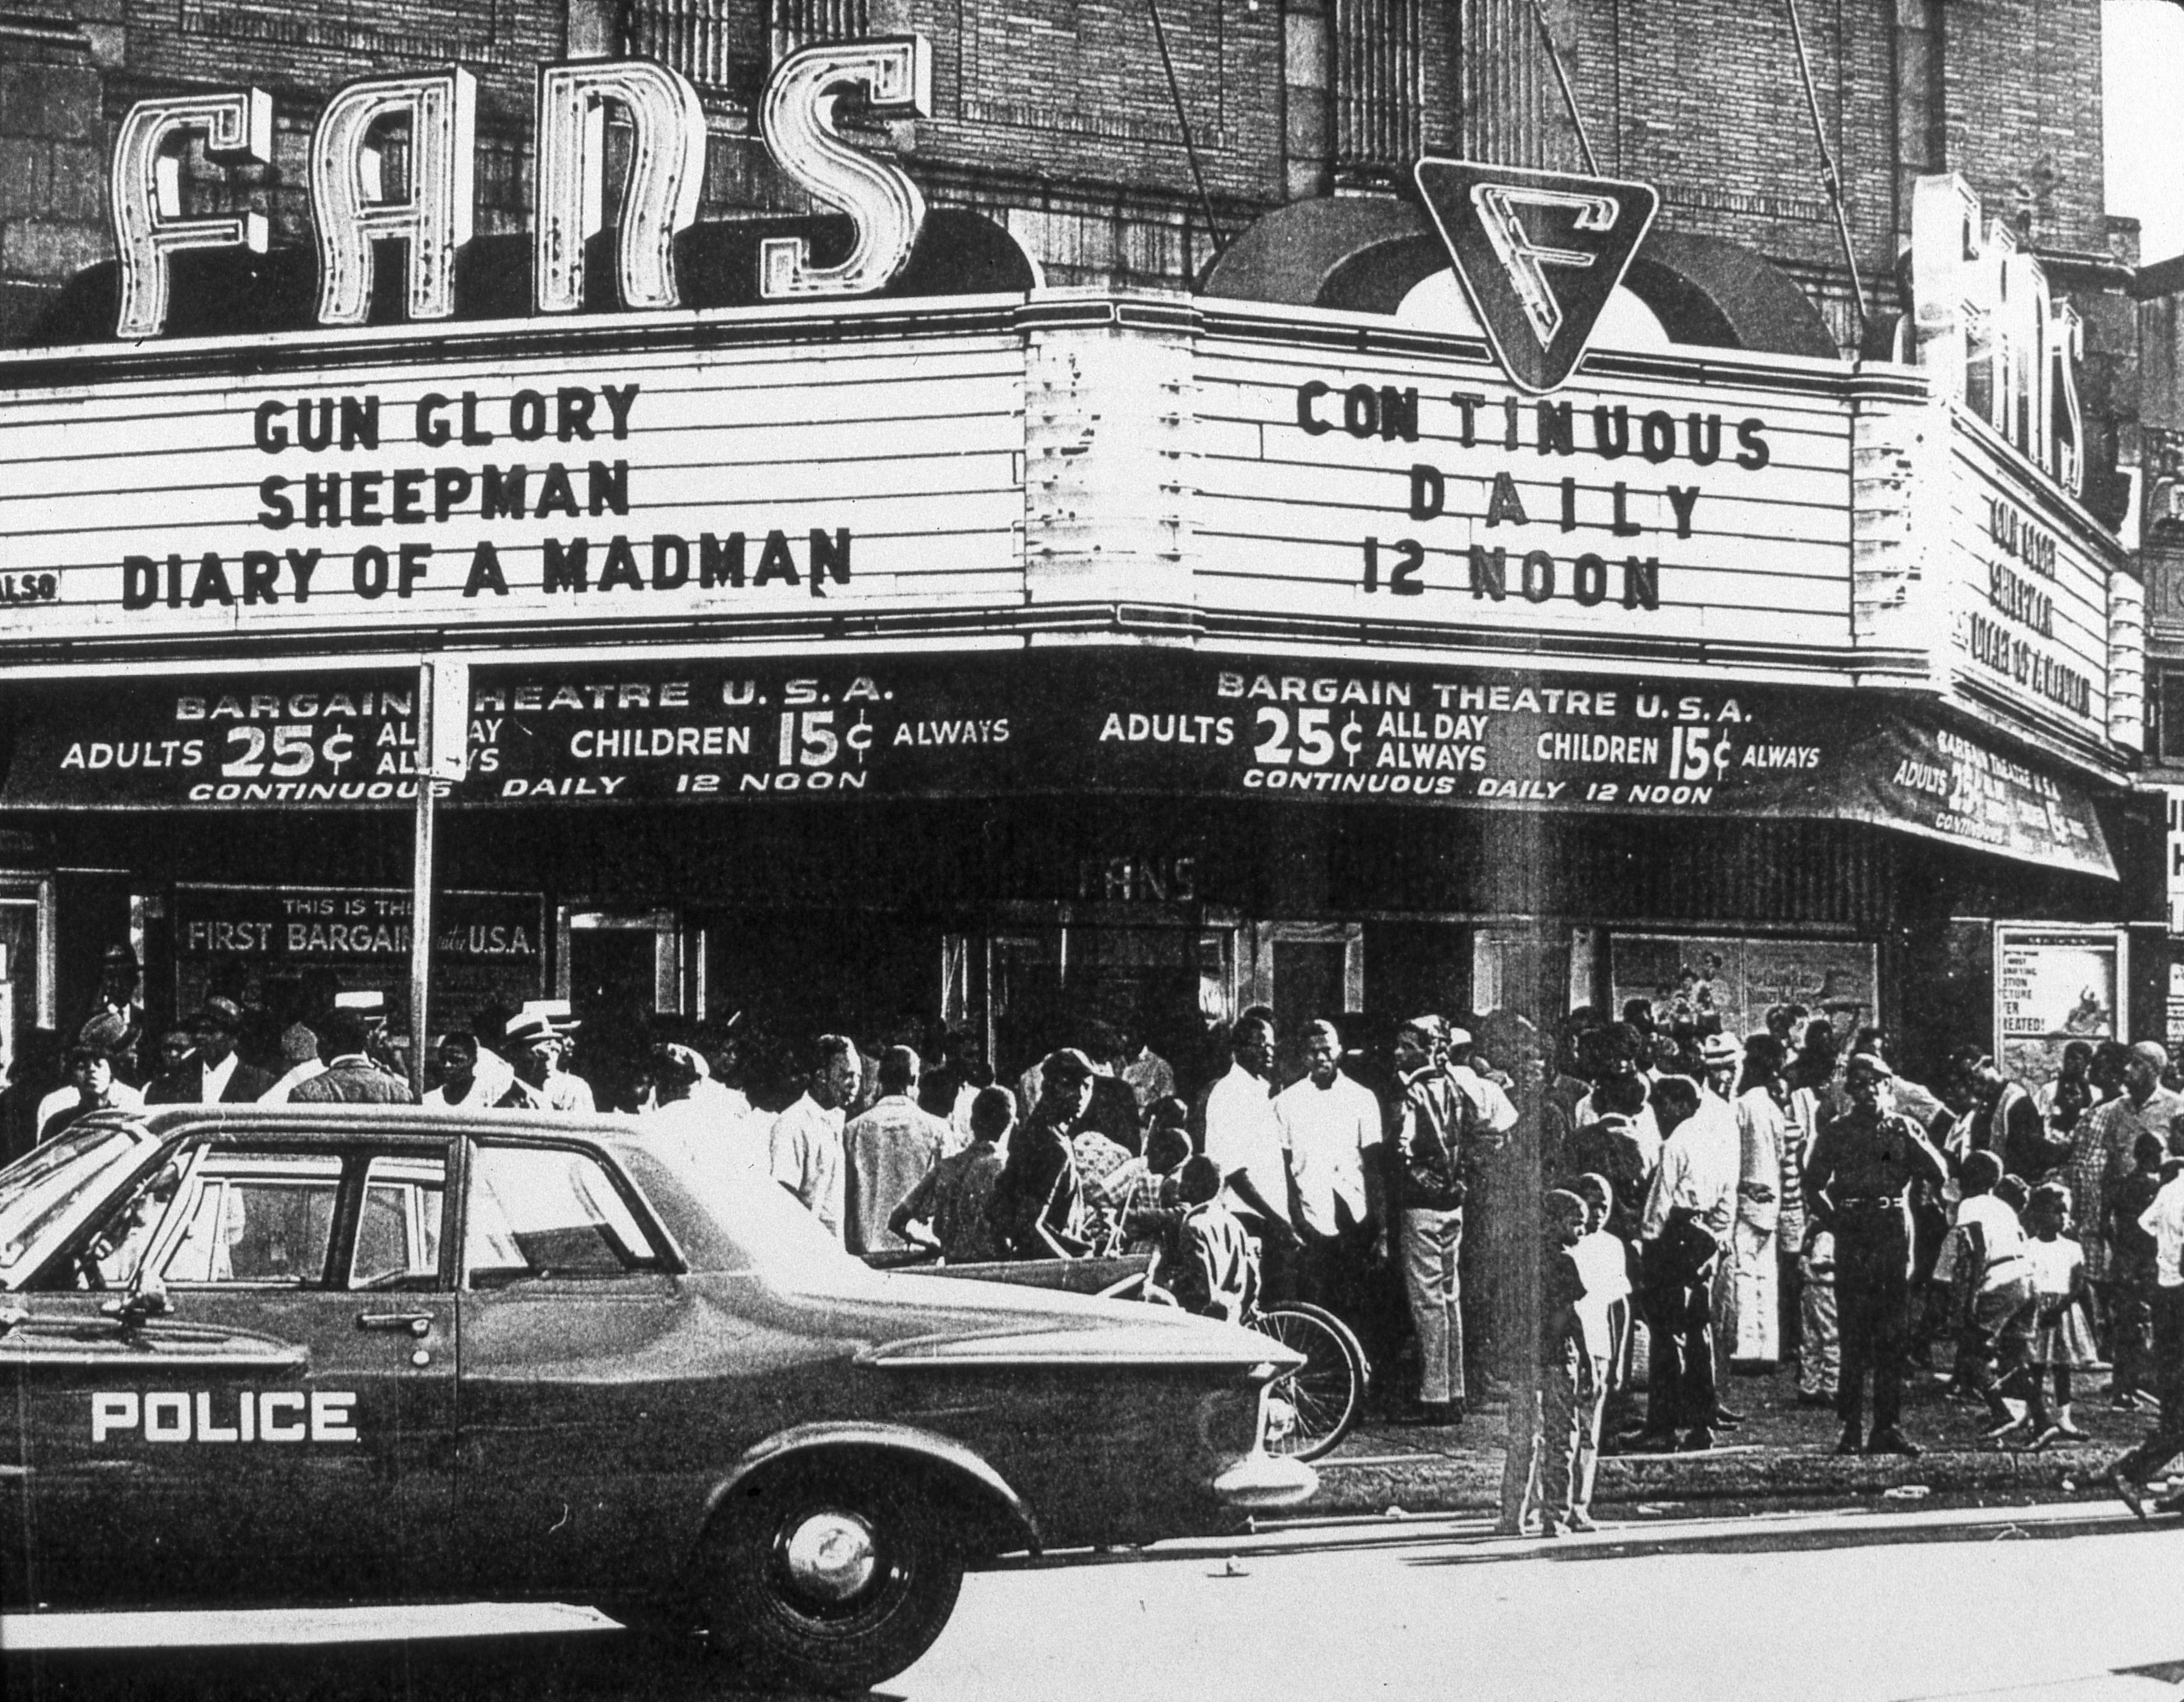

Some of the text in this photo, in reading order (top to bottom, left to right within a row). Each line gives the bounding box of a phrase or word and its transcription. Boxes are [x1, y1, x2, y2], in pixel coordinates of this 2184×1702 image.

[112, 34, 932, 339] FANS
[1469, 182, 1620, 352] F
[254, 383, 640, 454] GUN GLORY
[258, 459, 629, 530] SHEEPMAN
[1409, 463, 1701, 539] DAILY
[0, 572, 57, 602] LSO
[122, 527, 850, 610] DIARY OF A MADMAN
[1363, 536, 1659, 611] 12 NOON
[176, 677, 894, 720] BARGAIN HEATRE U.S.A.
[1217, 672, 1753, 723] BARGAIN THEATRE U.S.A.
[61, 723, 355, 777] ADULTS 25¢
[376, 718, 503, 746] AL AY
[571, 709, 1010, 766] CHILDREN 15¢ ALWAYS
[1099, 707, 1364, 767] ADULTS 25¢
[1376, 711, 1488, 741] ALL DAY
[1376, 742, 1488, 771] ALWAYS
[1536, 726, 1821, 782] CHILDREN 15¢ ALWAYS
[1893, 759, 1948, 796] ADULTS
[188, 771, 868, 801] CONTINUOUS DAILY 12 NOON
[1243, 769, 1713, 805] CONTINUOUS DAILY 12 NOON
[282, 899, 334, 915] THIS
[344, 899, 366, 915] IS
[188, 921, 272, 950] FIRST
[469, 925, 536, 953] U.S.A.
[92, 1392, 357, 1442] POLICE
